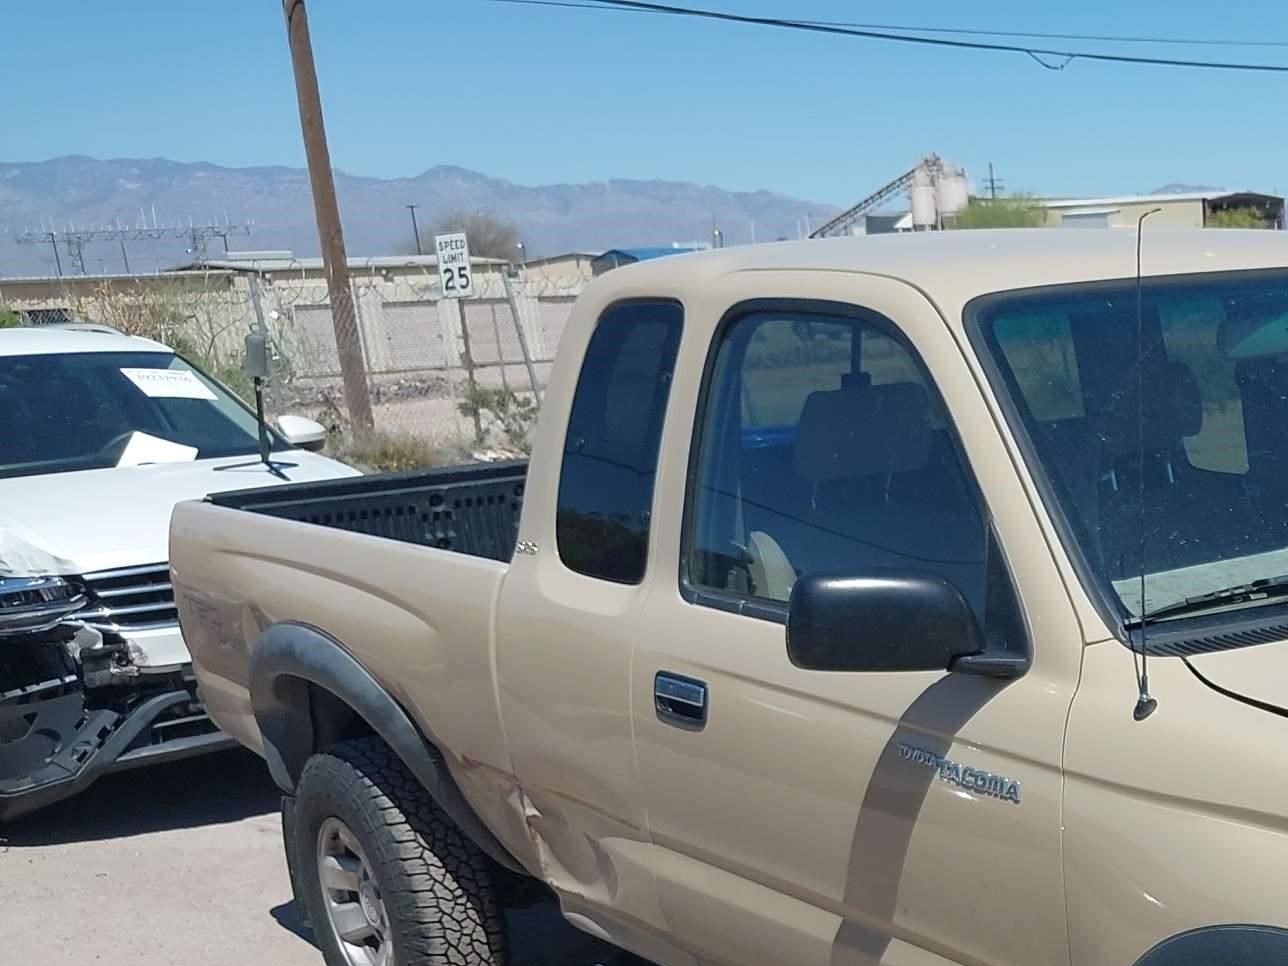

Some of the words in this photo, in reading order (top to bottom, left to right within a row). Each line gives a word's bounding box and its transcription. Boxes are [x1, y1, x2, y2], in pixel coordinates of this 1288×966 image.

[439, 239, 466, 251] SPEED
[442, 253, 464, 264] LIMIT
[443, 266, 470, 290] 25
[938, 760, 1020, 802] TACOMA
